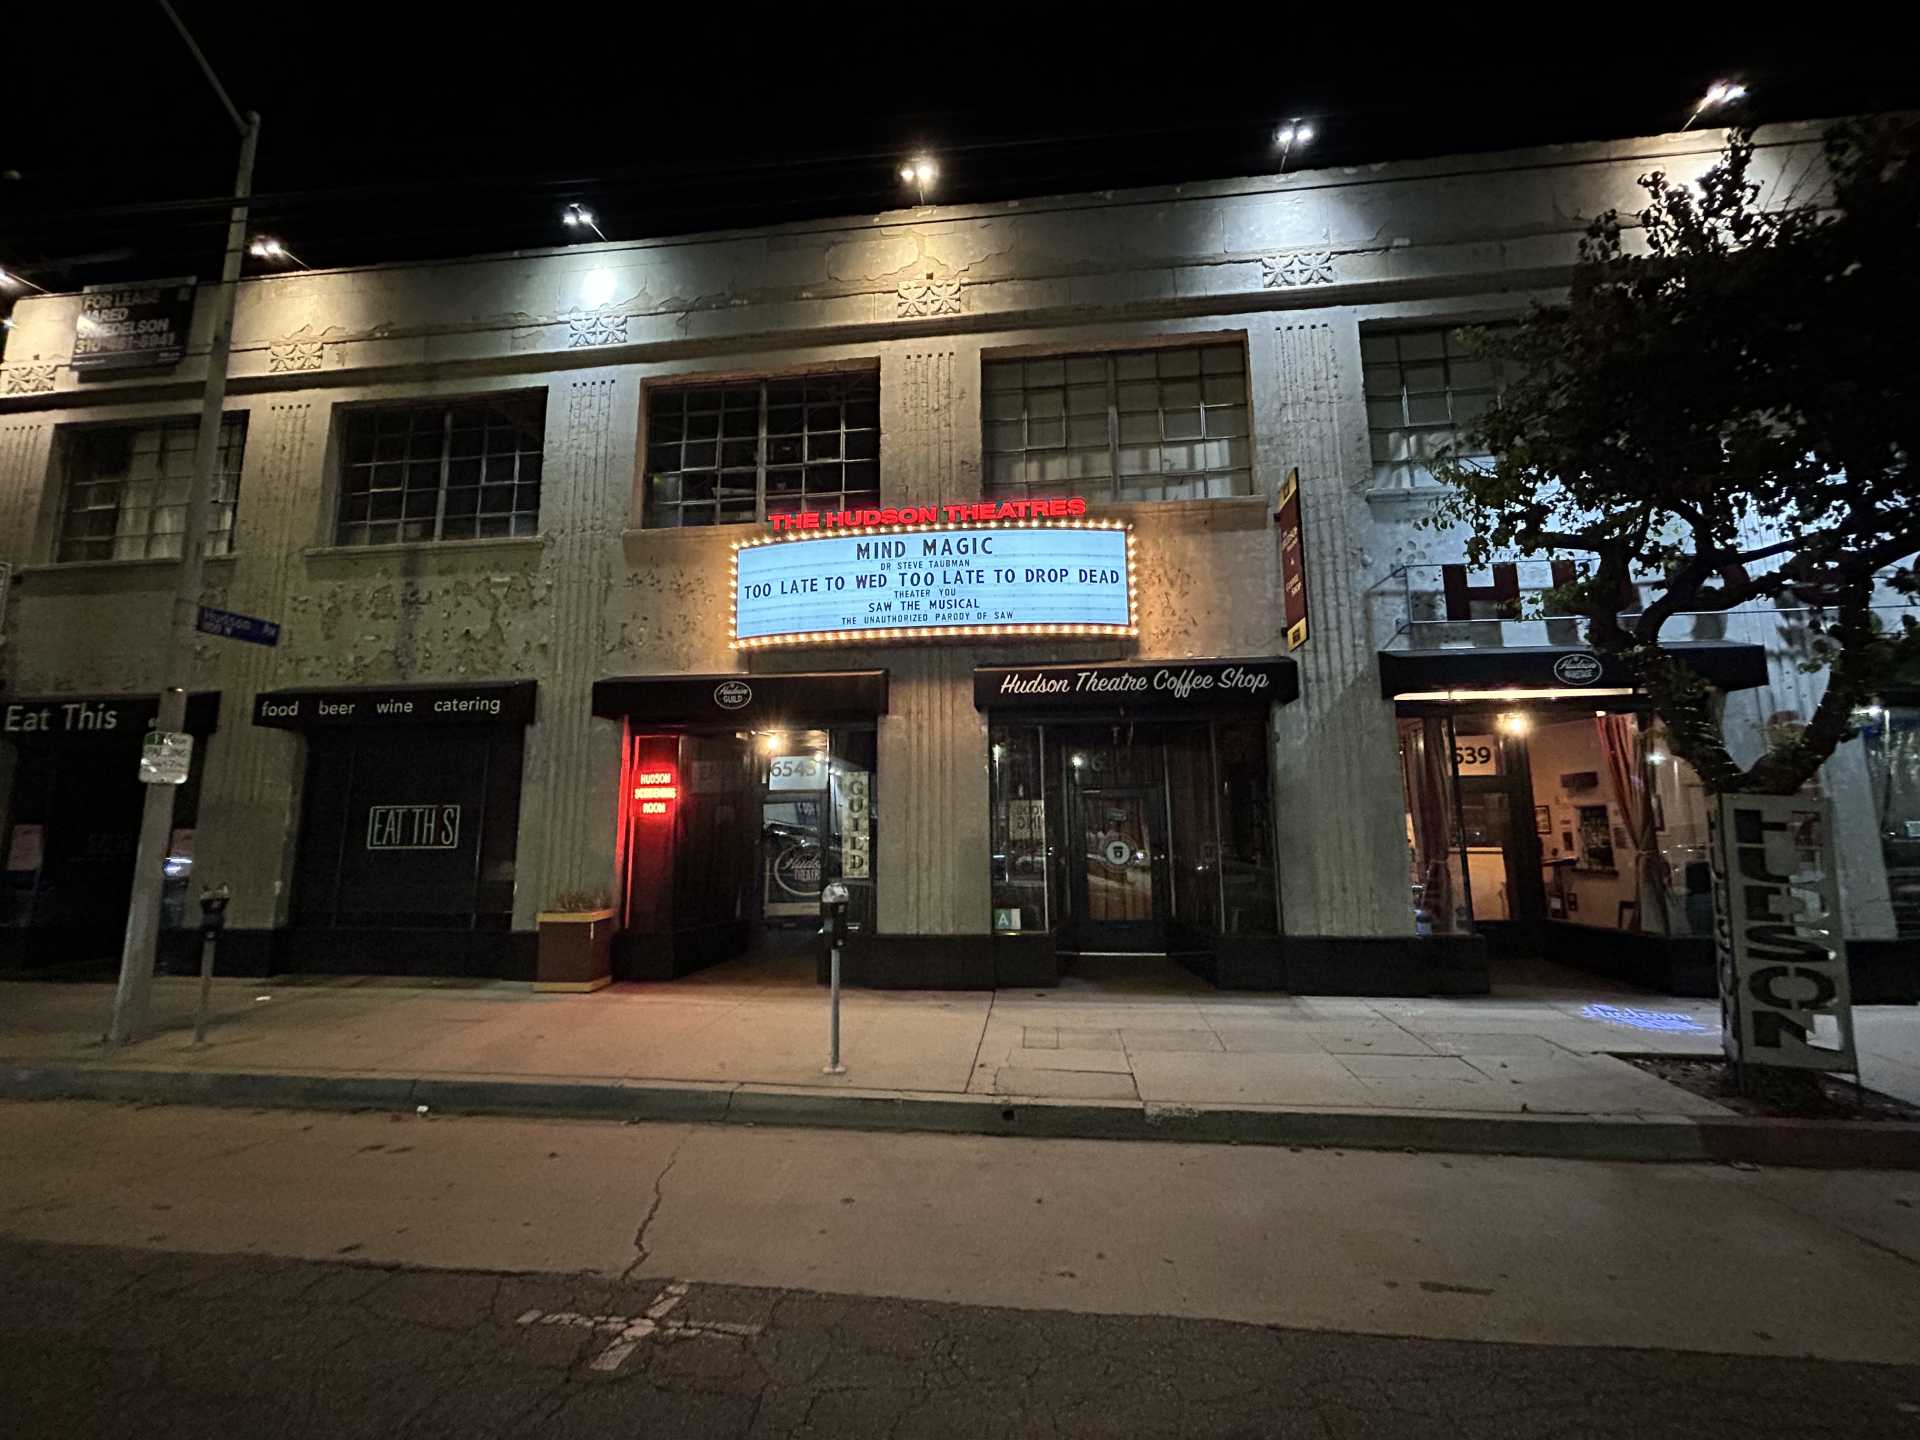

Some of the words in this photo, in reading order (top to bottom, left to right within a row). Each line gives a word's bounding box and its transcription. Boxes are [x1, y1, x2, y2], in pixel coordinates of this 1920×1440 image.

[768, 511, 820, 530] THE
[826, 505, 938, 528] HUDSON
[943, 497, 1087, 522] THEATRES
[856, 540, 907, 561] MIND
[922, 537, 993, 557] MAGIC
[880, 561, 891, 571] DR
[897, 560, 923, 570] STEVE
[928, 559, 970, 568] TAUBMAN
[744, 583, 772, 600] TOO
[780, 577, 819, 595] LATE
[825, 576, 846, 591] TO
[855, 573, 888, 589] WED
[898, 572, 935, 588] TOO
[943, 569, 985, 585] LATE
[993, 568, 1016, 583] TO
[1025, 568, 1069, 584] DROP
[1078, 569, 1120, 584] DEAD
[894, 589, 931, 599] THEATER
[938, 588, 956, 597] YOU
[868, 601, 893, 613] SAW
[901, 600, 921, 611] THE
[929, 599, 981, 611] MUSICAL
[841, 616, 857, 626] THE
[863, 613, 929, 625] UNAUTHORIZED
[935, 611, 970, 622] PARODY
[976, 611, 988, 621] OF
[994, 611, 1014, 621] SAW
[1000, 673, 1071, 694] Hudson
[1073, 671, 1148, 692] Theatre
[1153, 669, 1215, 698] Coffee
[1217, 667, 1270, 694] Shop
[261, 701, 299, 717] food
[318, 700, 355, 715] beer
[376, 699, 414, 713] wine
[434, 697, 501, 714] catering
[4, 705, 49, 732] Eat
[61, 703, 118, 731] This
[640, 773, 672, 785] HUDSON
[642, 802, 666, 814] ROOM
[372, 808, 404, 846] EAT
[411, 807, 456, 846] THS
[849, 780, 864, 870] GUILD
[998, 912, 1009, 926] A
